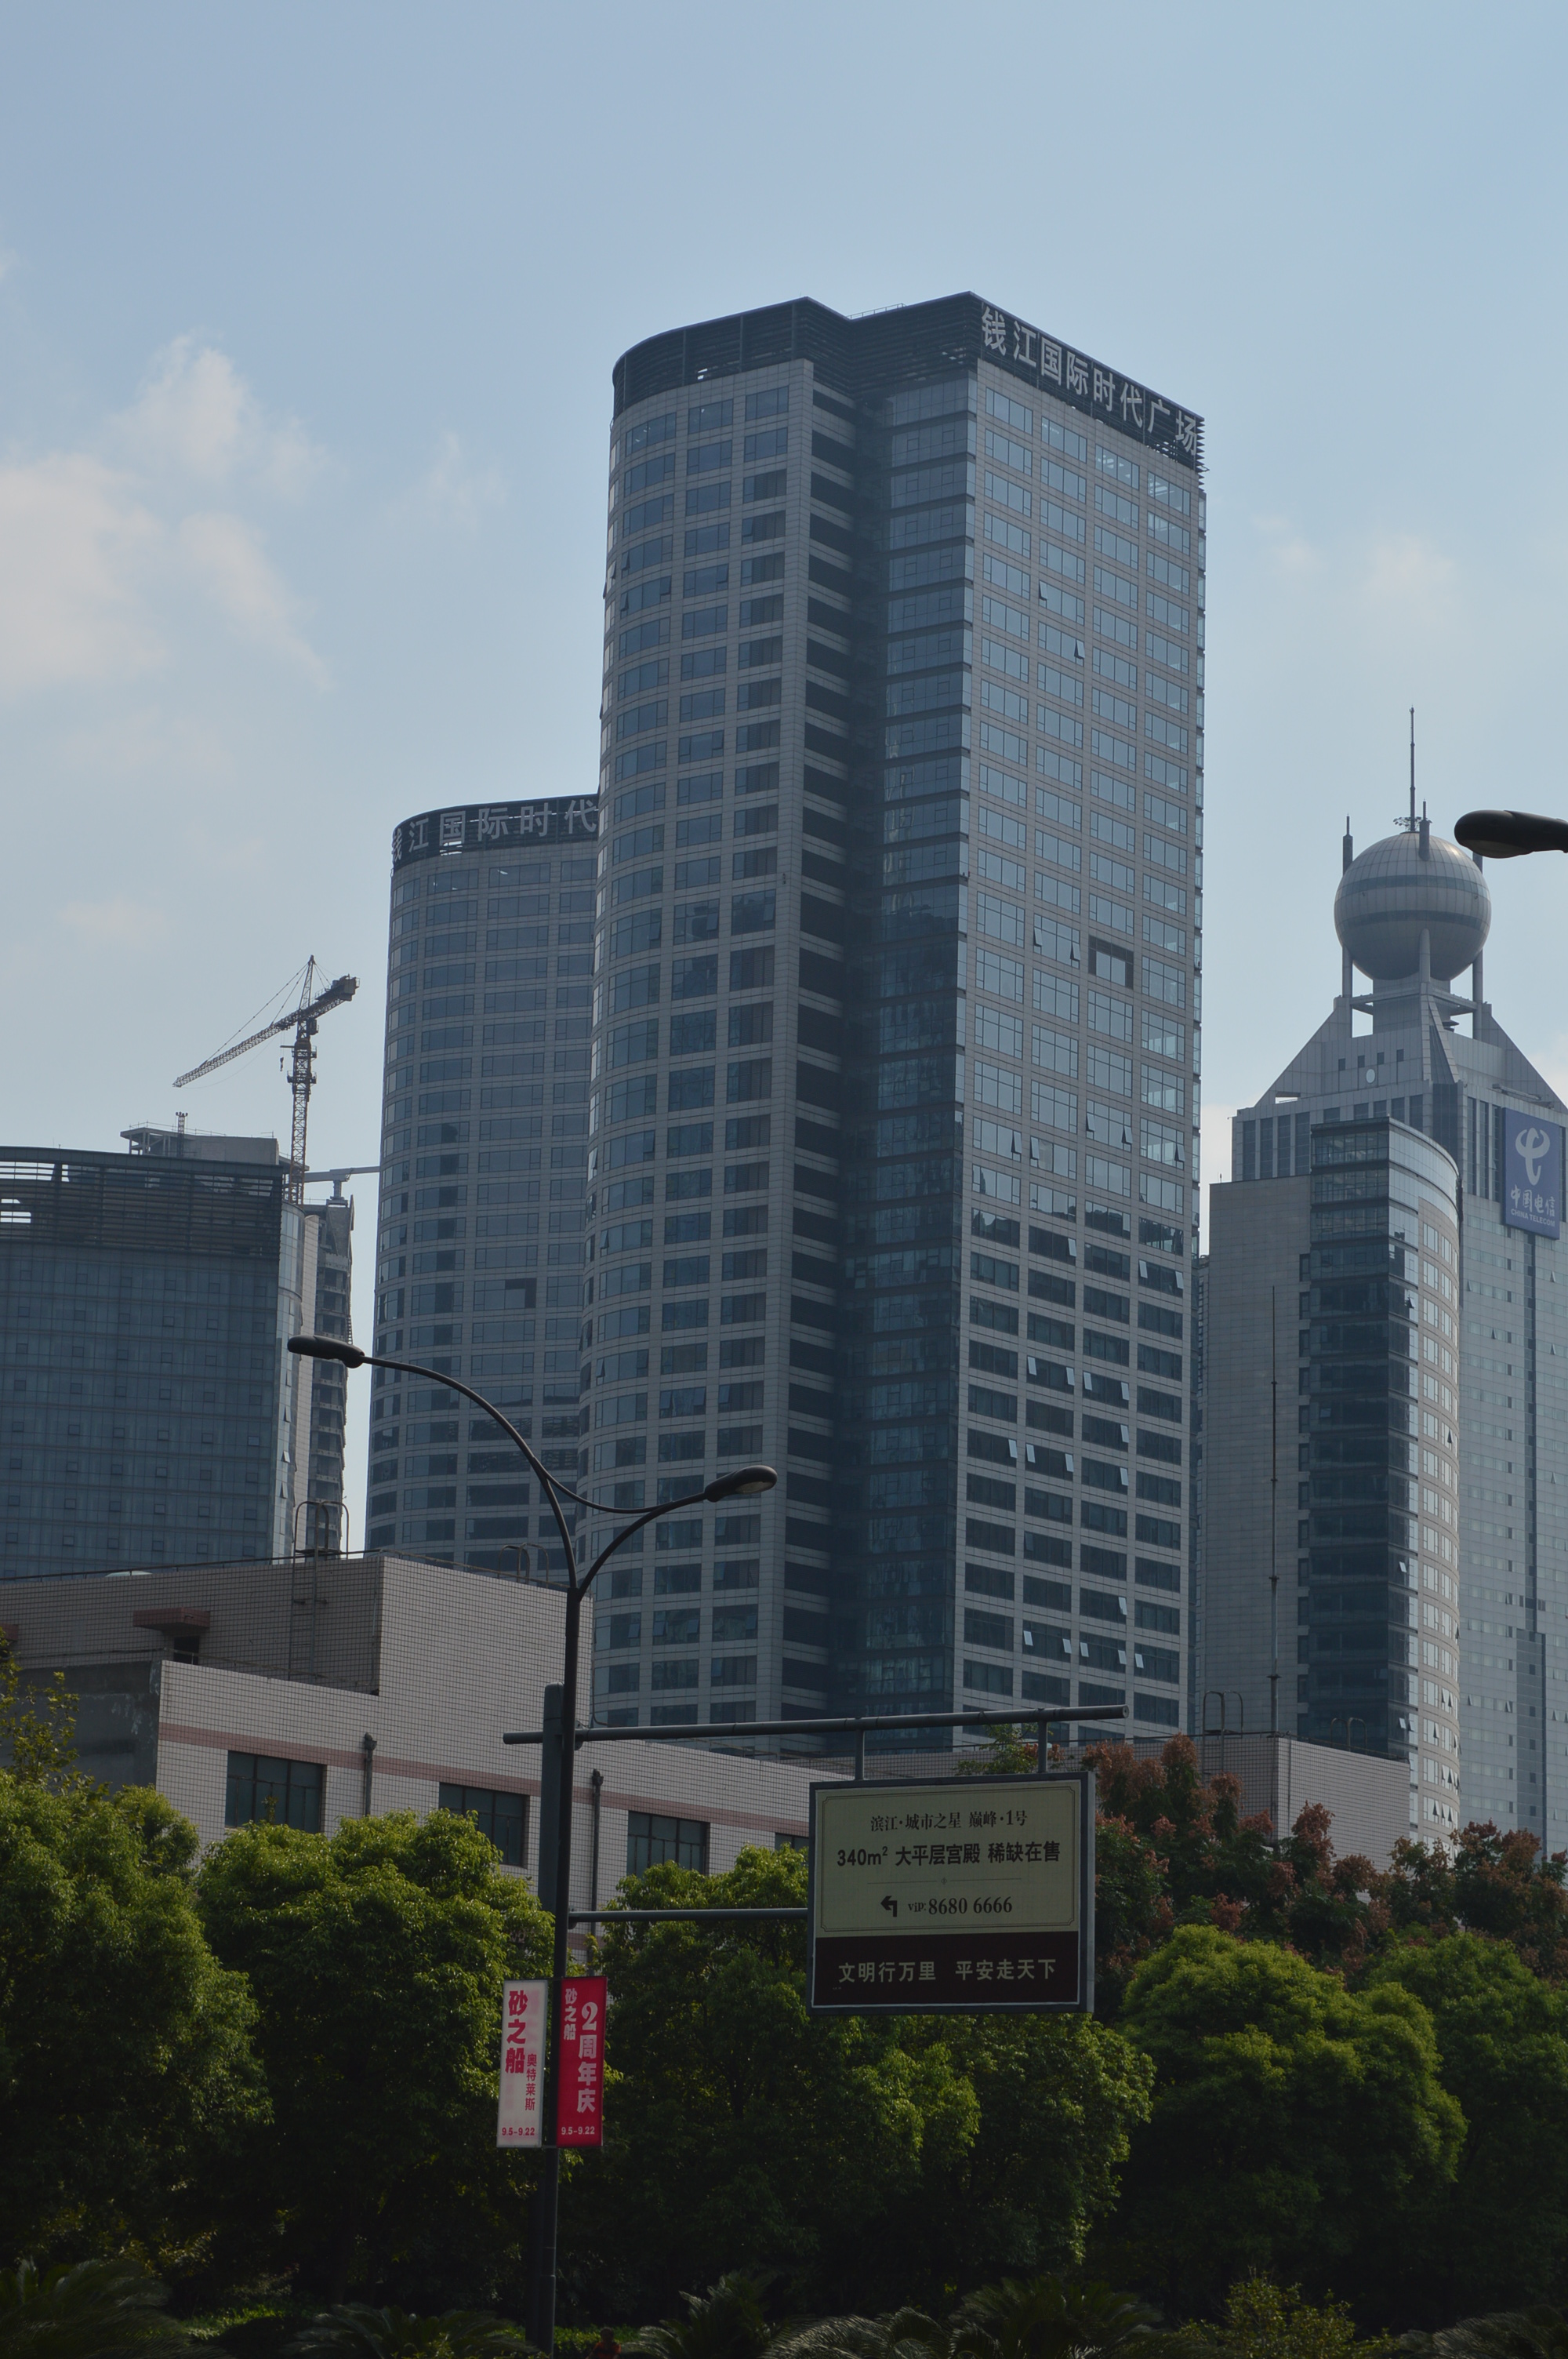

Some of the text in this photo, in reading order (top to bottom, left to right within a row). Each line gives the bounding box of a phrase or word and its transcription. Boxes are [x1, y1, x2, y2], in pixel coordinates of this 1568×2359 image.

[982, 307, 1197, 456] 钱江国际时代广场
[1511, 1184, 1555, 1217] 中国电信
[1512, 1208, 1555, 1227] CHINA TELECOM
[871, 1810, 1028, 1832] 滨江·城市之星 巅峰·1号
[895, 1843, 980, 1866] 大平层宫殿
[988, 1841, 1060, 1863] 稀缺在售
[973, 1896, 1012, 1914] 6666
[839, 1959, 1056, 1983] 文明行万里 平安走天下
[564, 1989, 577, 2041] 砂之船
[505, 1990, 528, 2074] 砂之船
[577, 2002, 598, 2114] 2周年庆
[525, 2054, 537, 2110] 奥特莱斯
[502, 2127, 535, 2136] 9.5-9.22
[561, 2126, 595, 2135] 9.5-9.22
